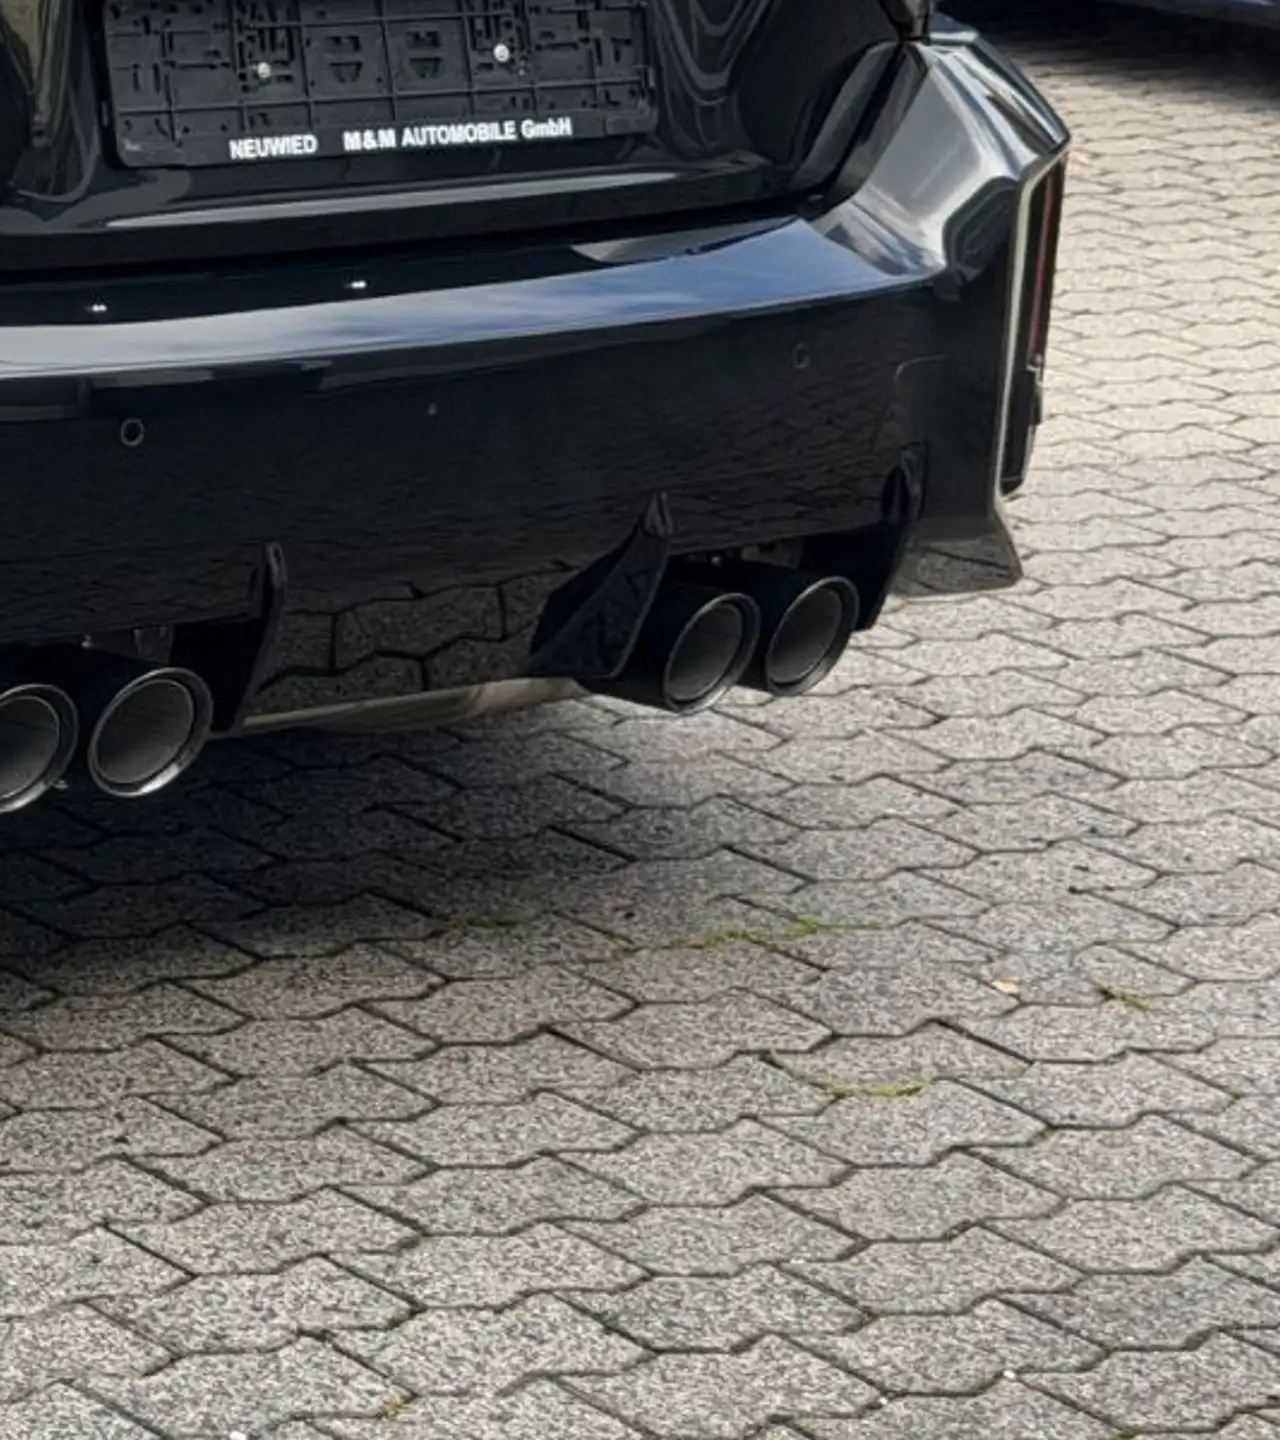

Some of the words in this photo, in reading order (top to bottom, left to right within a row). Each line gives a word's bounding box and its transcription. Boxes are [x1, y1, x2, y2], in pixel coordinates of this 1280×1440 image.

[228, 133, 319, 160] NEUWIED
[342, 127, 397, 152] M&M
[401, 120, 517, 147] AUTOMOBILE
[520, 116, 573, 139] GmbH
